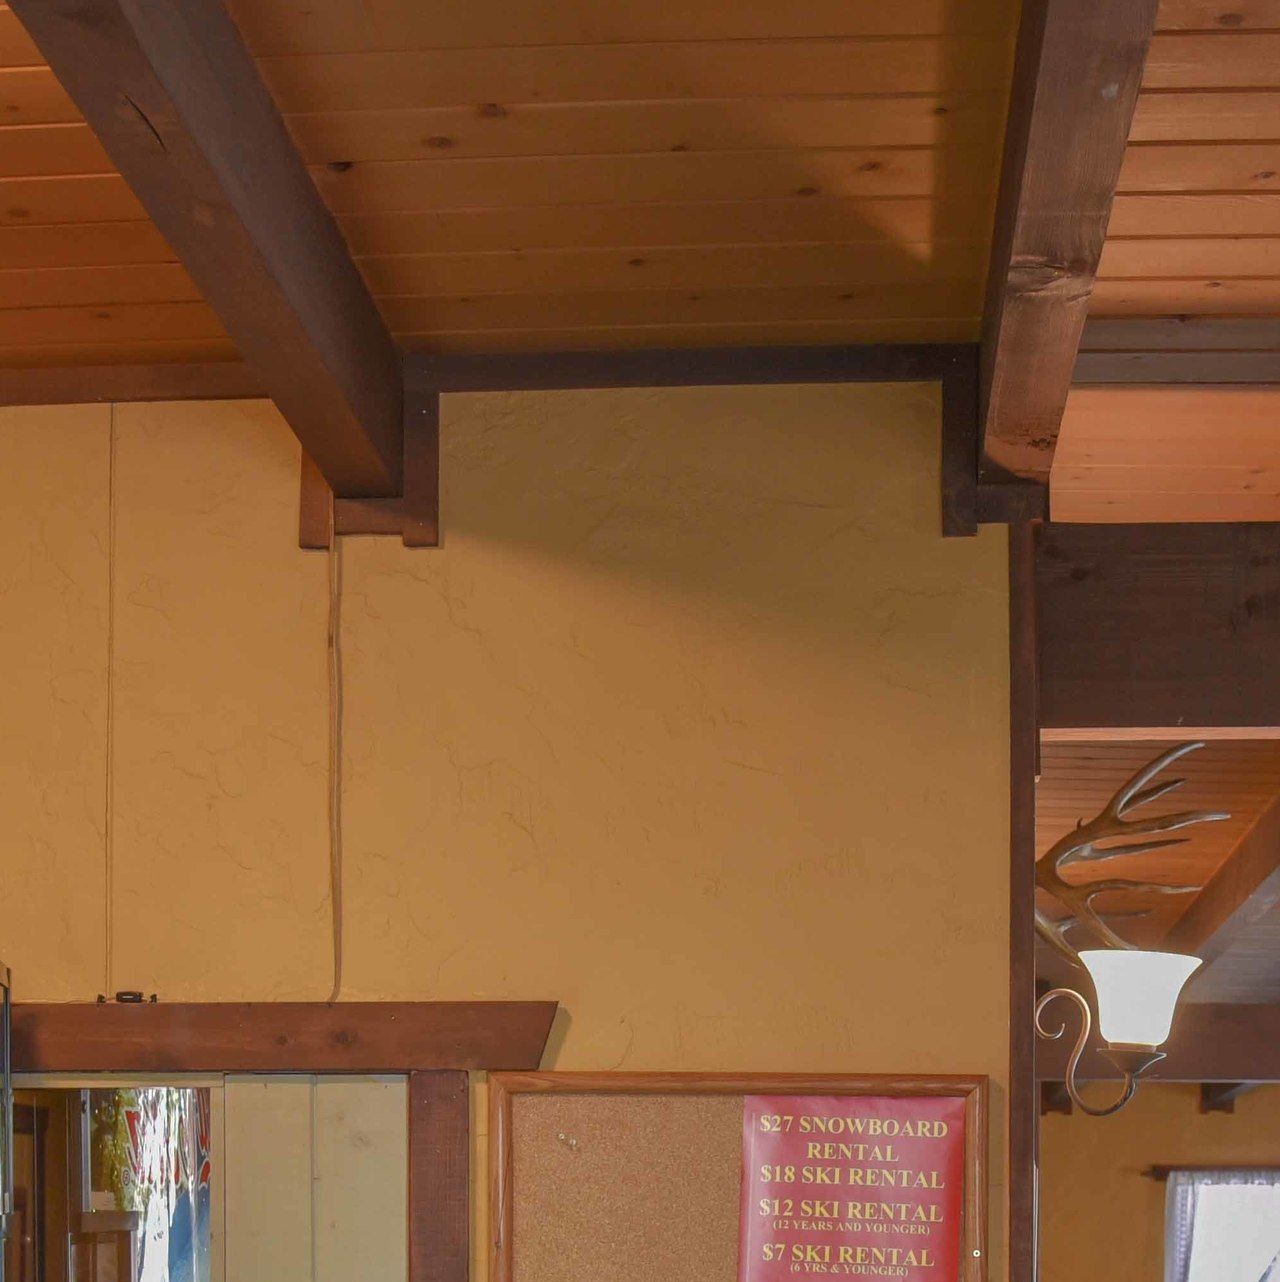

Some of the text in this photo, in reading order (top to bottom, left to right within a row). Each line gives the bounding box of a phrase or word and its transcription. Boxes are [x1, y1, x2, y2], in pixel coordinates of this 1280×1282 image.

[760, 1115, 948, 1137] $27 SNOWBOARD
[807, 1142, 898, 1162] RENTAL
[760, 1165, 945, 1189] $18 SKI RENTAL
[759, 1198, 944, 1222] $12 SKI RENTAL
[773, 1219, 930, 1235] (12 YEARS AND YOUNGER)
[762, 1243, 935, 1267] $7 SKI RENTAL
[790, 1262, 908, 1277] (6 YRS & YOUNGER)
